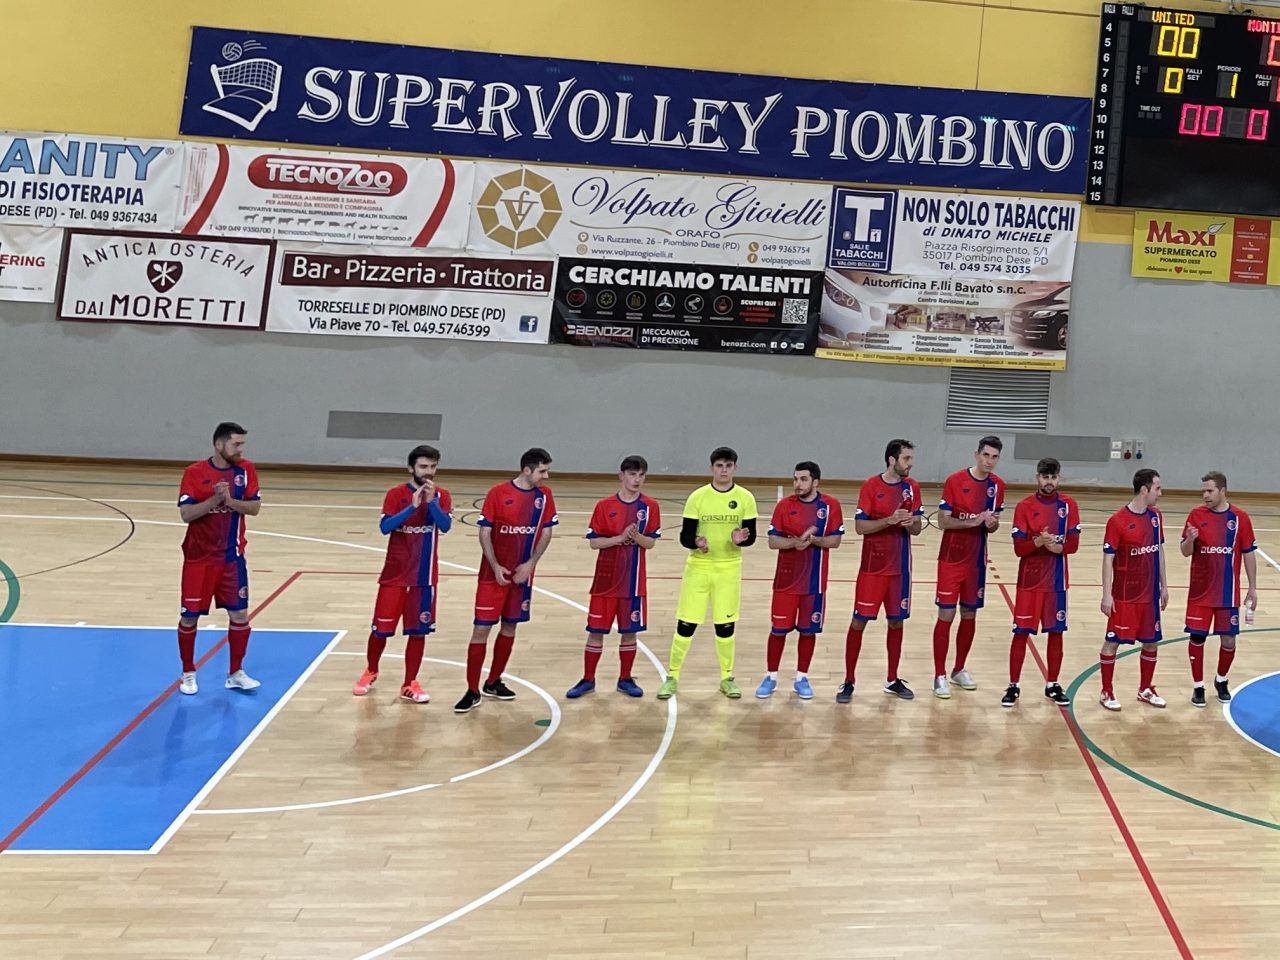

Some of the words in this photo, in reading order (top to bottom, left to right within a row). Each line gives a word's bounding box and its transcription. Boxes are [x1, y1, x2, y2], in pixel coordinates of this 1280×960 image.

[1106, 23, 1112, 32] 4
[1104, 38, 1111, 47] 5
[1157, 25, 1200, 58] 00
[1103, 53, 1110, 62] 6
[1102, 69, 1109, 77] 7
[1164, 68, 1183, 94] 0
[1101, 84, 1107, 93] 8
[1100, 99, 1106, 108] 9
[297, 66, 784, 155] SUPERVOLLEY
[790, 105, 1075, 172] PIOMBINO
[1097, 115, 1107, 123] 10
[1095, 130, 1104, 139] 11
[1094, 146, 1104, 154] 12
[1093, 161, 1103, 169] 13
[1091, 176, 1102, 185] 14
[22, 182, 143, 205] FISIOTERAPIA
[1090, 192, 1100, 200] 15
[572, 176, 699, 225] Volpato
[705, 182, 827, 230] Gioielli
[35, 207, 57, 220] (PD)
[69, 208, 86, 219] Tel.
[91, 210, 108, 221] 049
[113, 211, 157, 223] 9367434
[845, 196, 885, 241] T
[902, 197, 941, 223] NON
[945, 200, 989, 227] SOLO
[995, 204, 1075, 231] TABACCHI
[676, 229, 721, 239] ORAFO
[923, 227, 936, 236] di
[941, 228, 991, 239] DINATO
[996, 231, 1052, 243] MICHELE
[1146, 220, 1217, 246] Maxi
[663, 239, 698, 247] Piombino
[723, 242, 740, 251] (PD)
[925, 241, 957, 250] Piazza
[961, 243, 1030, 255] Risorgimento,
[1034, 247, 1048, 256] 5/1
[835, 249, 883, 259] TABACCHI
[923, 251, 952, 260] 35017
[956, 253, 1003, 263] Piombino
[1007, 256, 1031, 264] Dese
[1034, 257, 1049, 265] PD
[1144, 247, 1217, 258] SUPERMERCATO
[82, 242, 157, 268] ANTICA
[170, 243, 255, 278] OSTERIA
[761, 256, 811, 266] volpatogioielli
[293, 255, 331, 279] Bar
[345, 259, 436, 284] Pizzeria
[451, 263, 545, 290] Trattoria
[939, 262, 956, 270] Tel.
[960, 263, 980, 271] 049
[984, 264, 1002, 272] 574
[1005, 265, 1031, 273] 3035
[569, 266, 714, 290] CERCHIAMO
[719, 274, 811, 294] TALENTI
[863, 277, 926, 290] Autofficina
[931, 281, 951, 291] F.lli
[955, 282, 993, 294] Bavato
[997, 285, 1026, 295] s.n.c.
[76, 300, 104, 315] DAI
[110, 294, 245, 323] MORETTI
[298, 300, 370, 315] TORRESELLE
[373, 303, 386, 314] DI
[389, 304, 448, 317] PIOMBINO
[450, 307, 479, 319] DESE
[482, 308, 505, 322] (PD)
[309, 317, 328, 330] Via
[330, 318, 362, 332] Piave
[365, 320, 380, 332] 70
[413, 322, 491, 337] 049.5746399
[576, 325, 633, 337] BENOZZI
[642, 328, 690, 337] MECCANICA
[652, 336, 699, 346] PRECISIONE
[721, 340, 766, 348] benozzi.com
